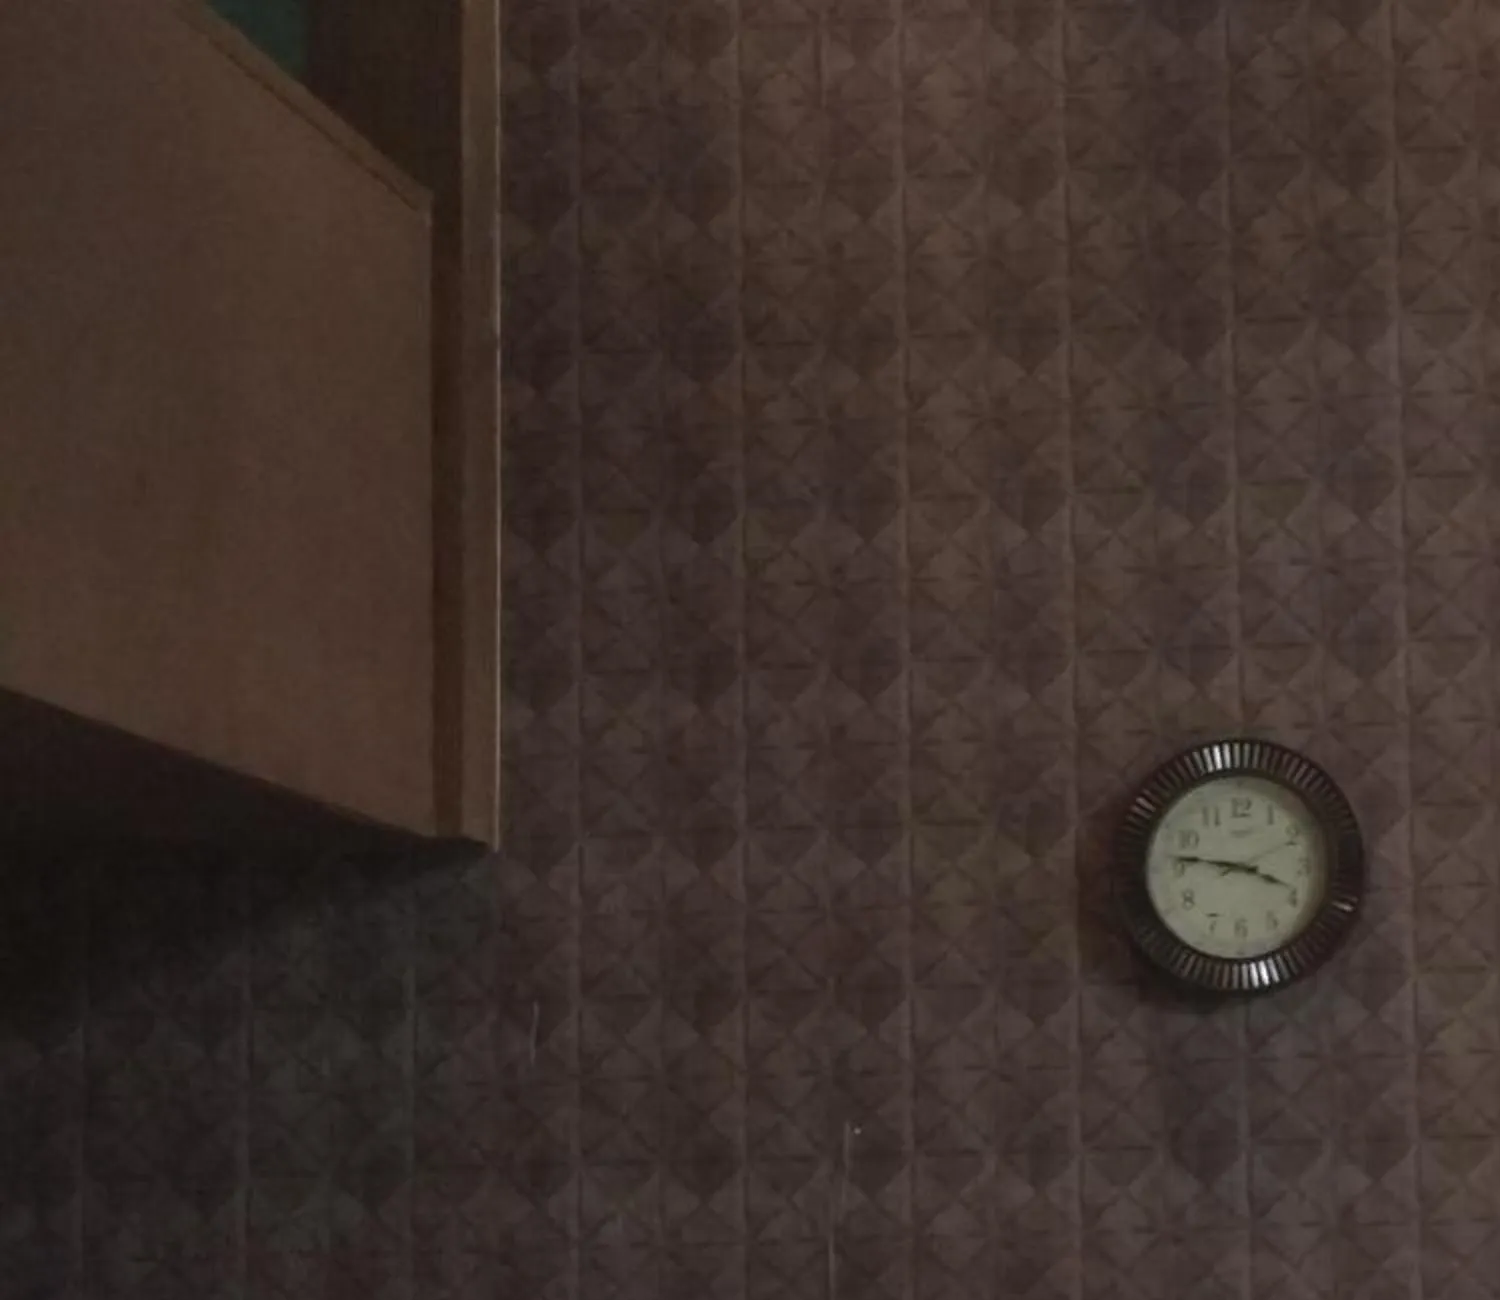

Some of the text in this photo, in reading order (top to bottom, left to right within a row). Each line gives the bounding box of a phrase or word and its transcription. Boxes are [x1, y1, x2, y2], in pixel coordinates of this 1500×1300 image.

[1201, 805, 1221, 826] 11
[1230, 797, 1252, 818] 12
[1266, 804, 1275, 825] 1
[1178, 829, 1200, 849] 10
[1285, 826, 1300, 846] 2
[1182, 889, 1195, 911] 8
[1286, 888, 1298, 908] 4
[1207, 912, 1222, 934] 7
[1234, 917, 1249, 938] 6
[1265, 909, 1279, 929] 5
